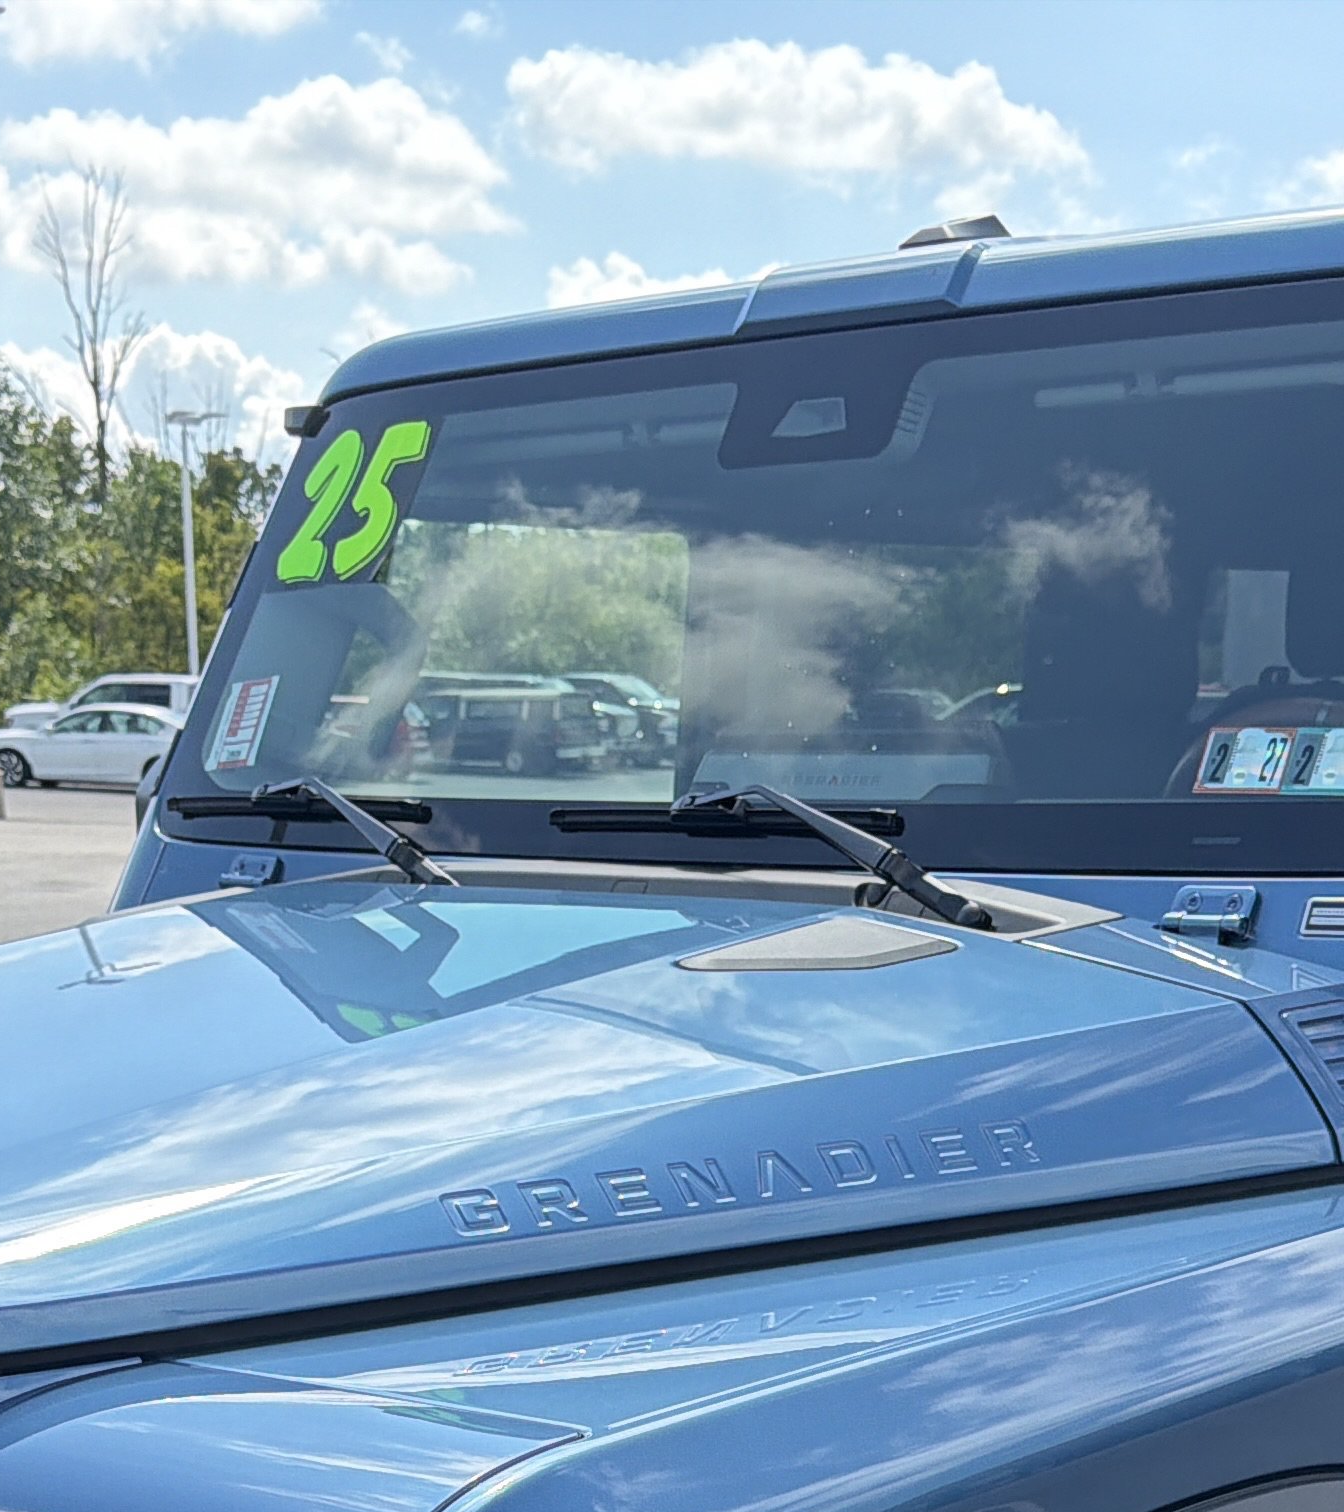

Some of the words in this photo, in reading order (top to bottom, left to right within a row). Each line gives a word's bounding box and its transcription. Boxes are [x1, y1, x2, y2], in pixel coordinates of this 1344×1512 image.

[277, 421, 431, 584] 25
[1208, 743, 1231, 783] 2
[1258, 737, 1288, 785] 27
[1292, 744, 1315, 785] 2
[437, 1117, 1041, 1238] GRENADIER
